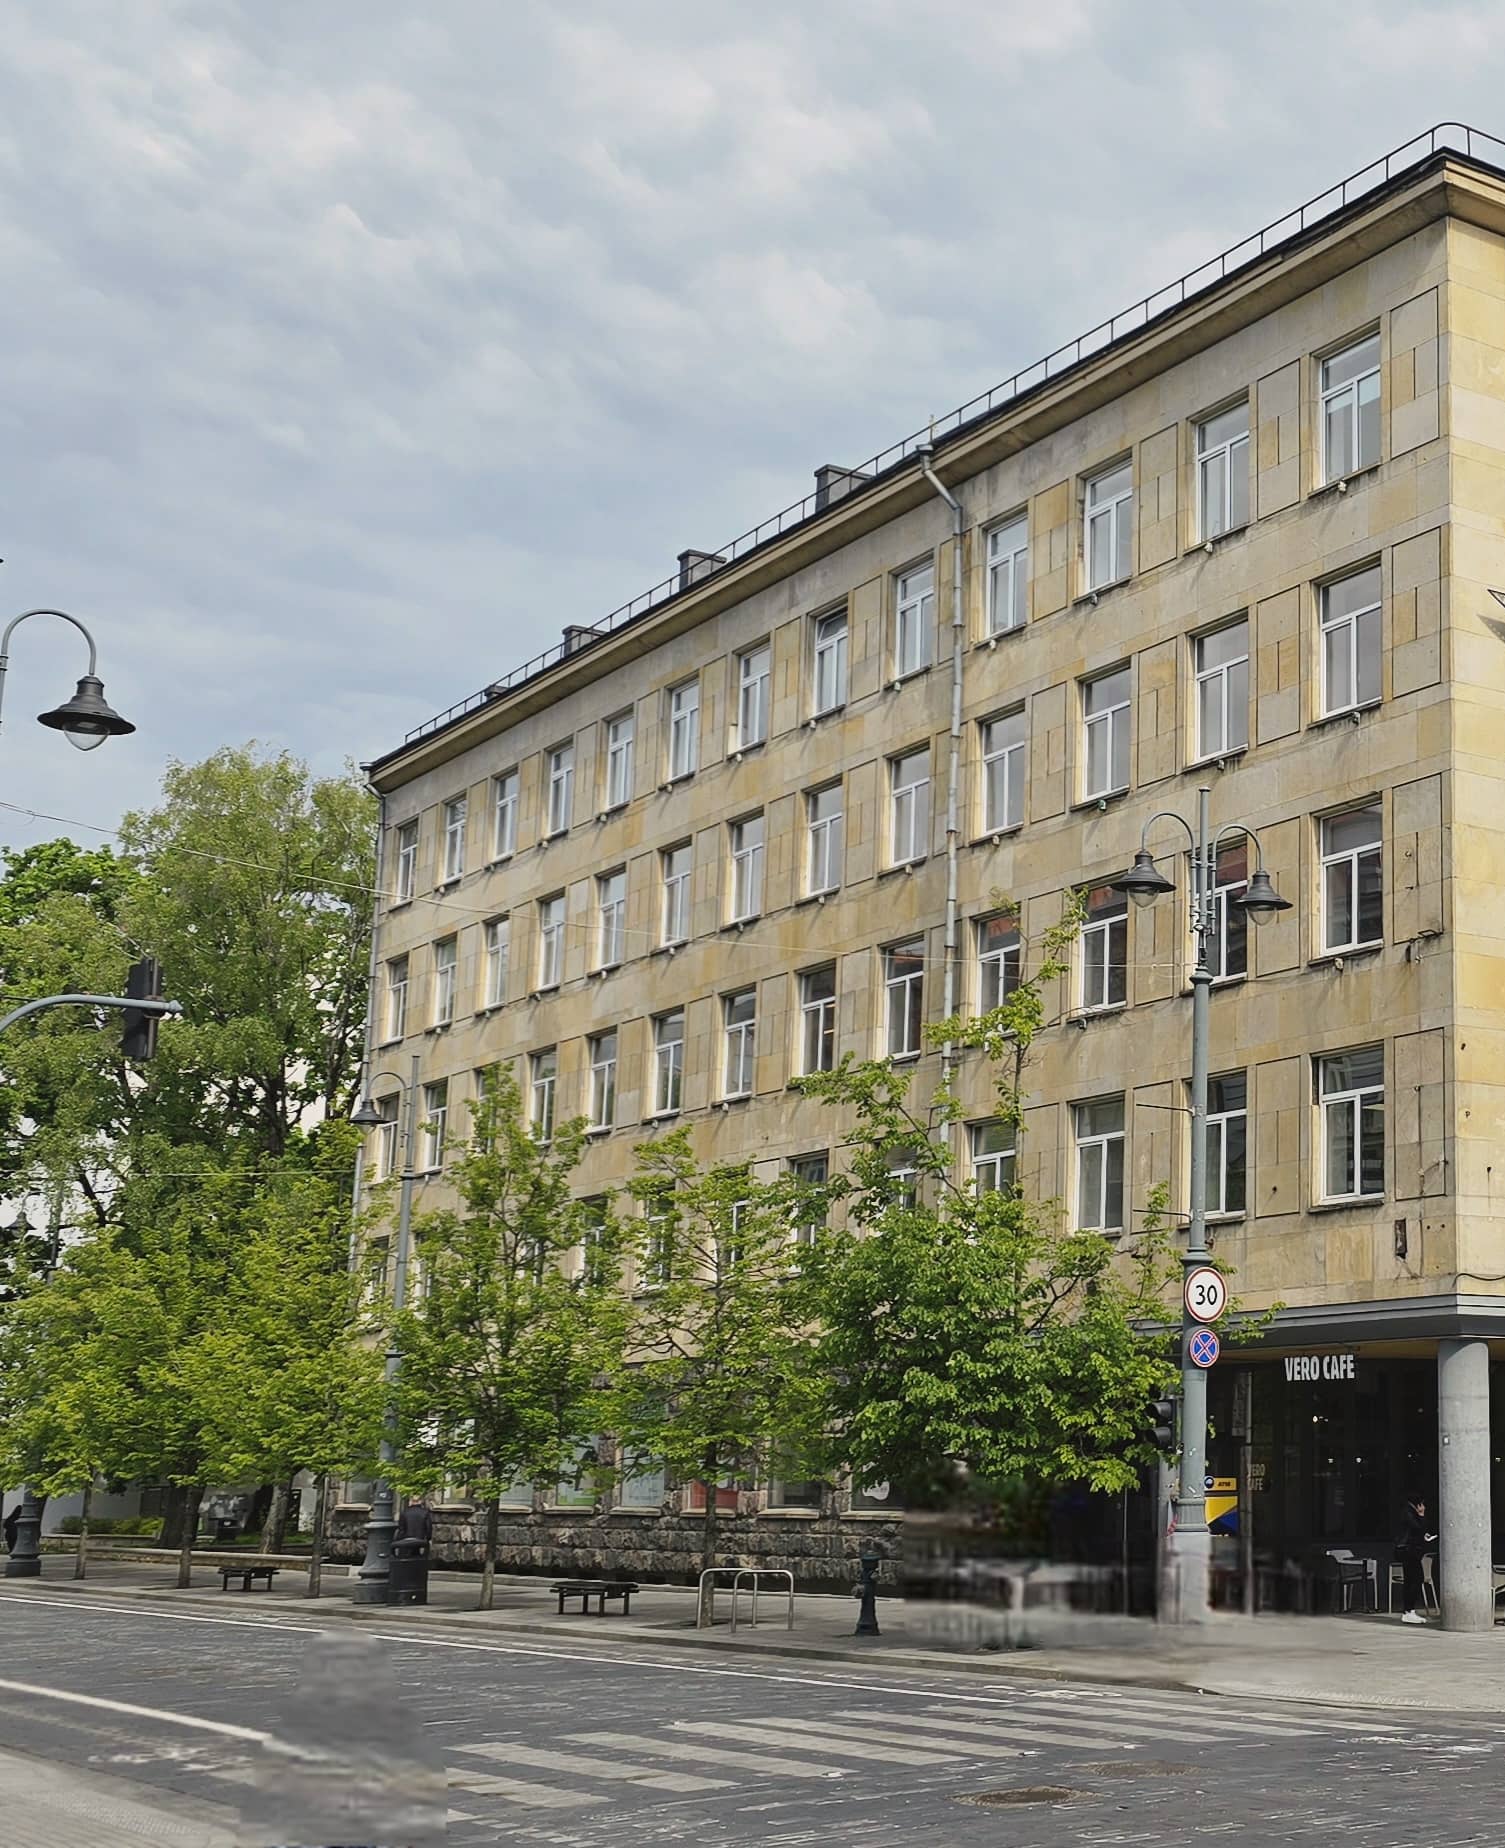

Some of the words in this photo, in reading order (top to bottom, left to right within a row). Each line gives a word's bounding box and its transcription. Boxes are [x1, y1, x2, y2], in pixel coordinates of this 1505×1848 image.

[1195, 1284, 1218, 1306] 30
[1284, 1355, 1320, 1382] VERO
[1322, 1354, 1355, 1380] CAFE
